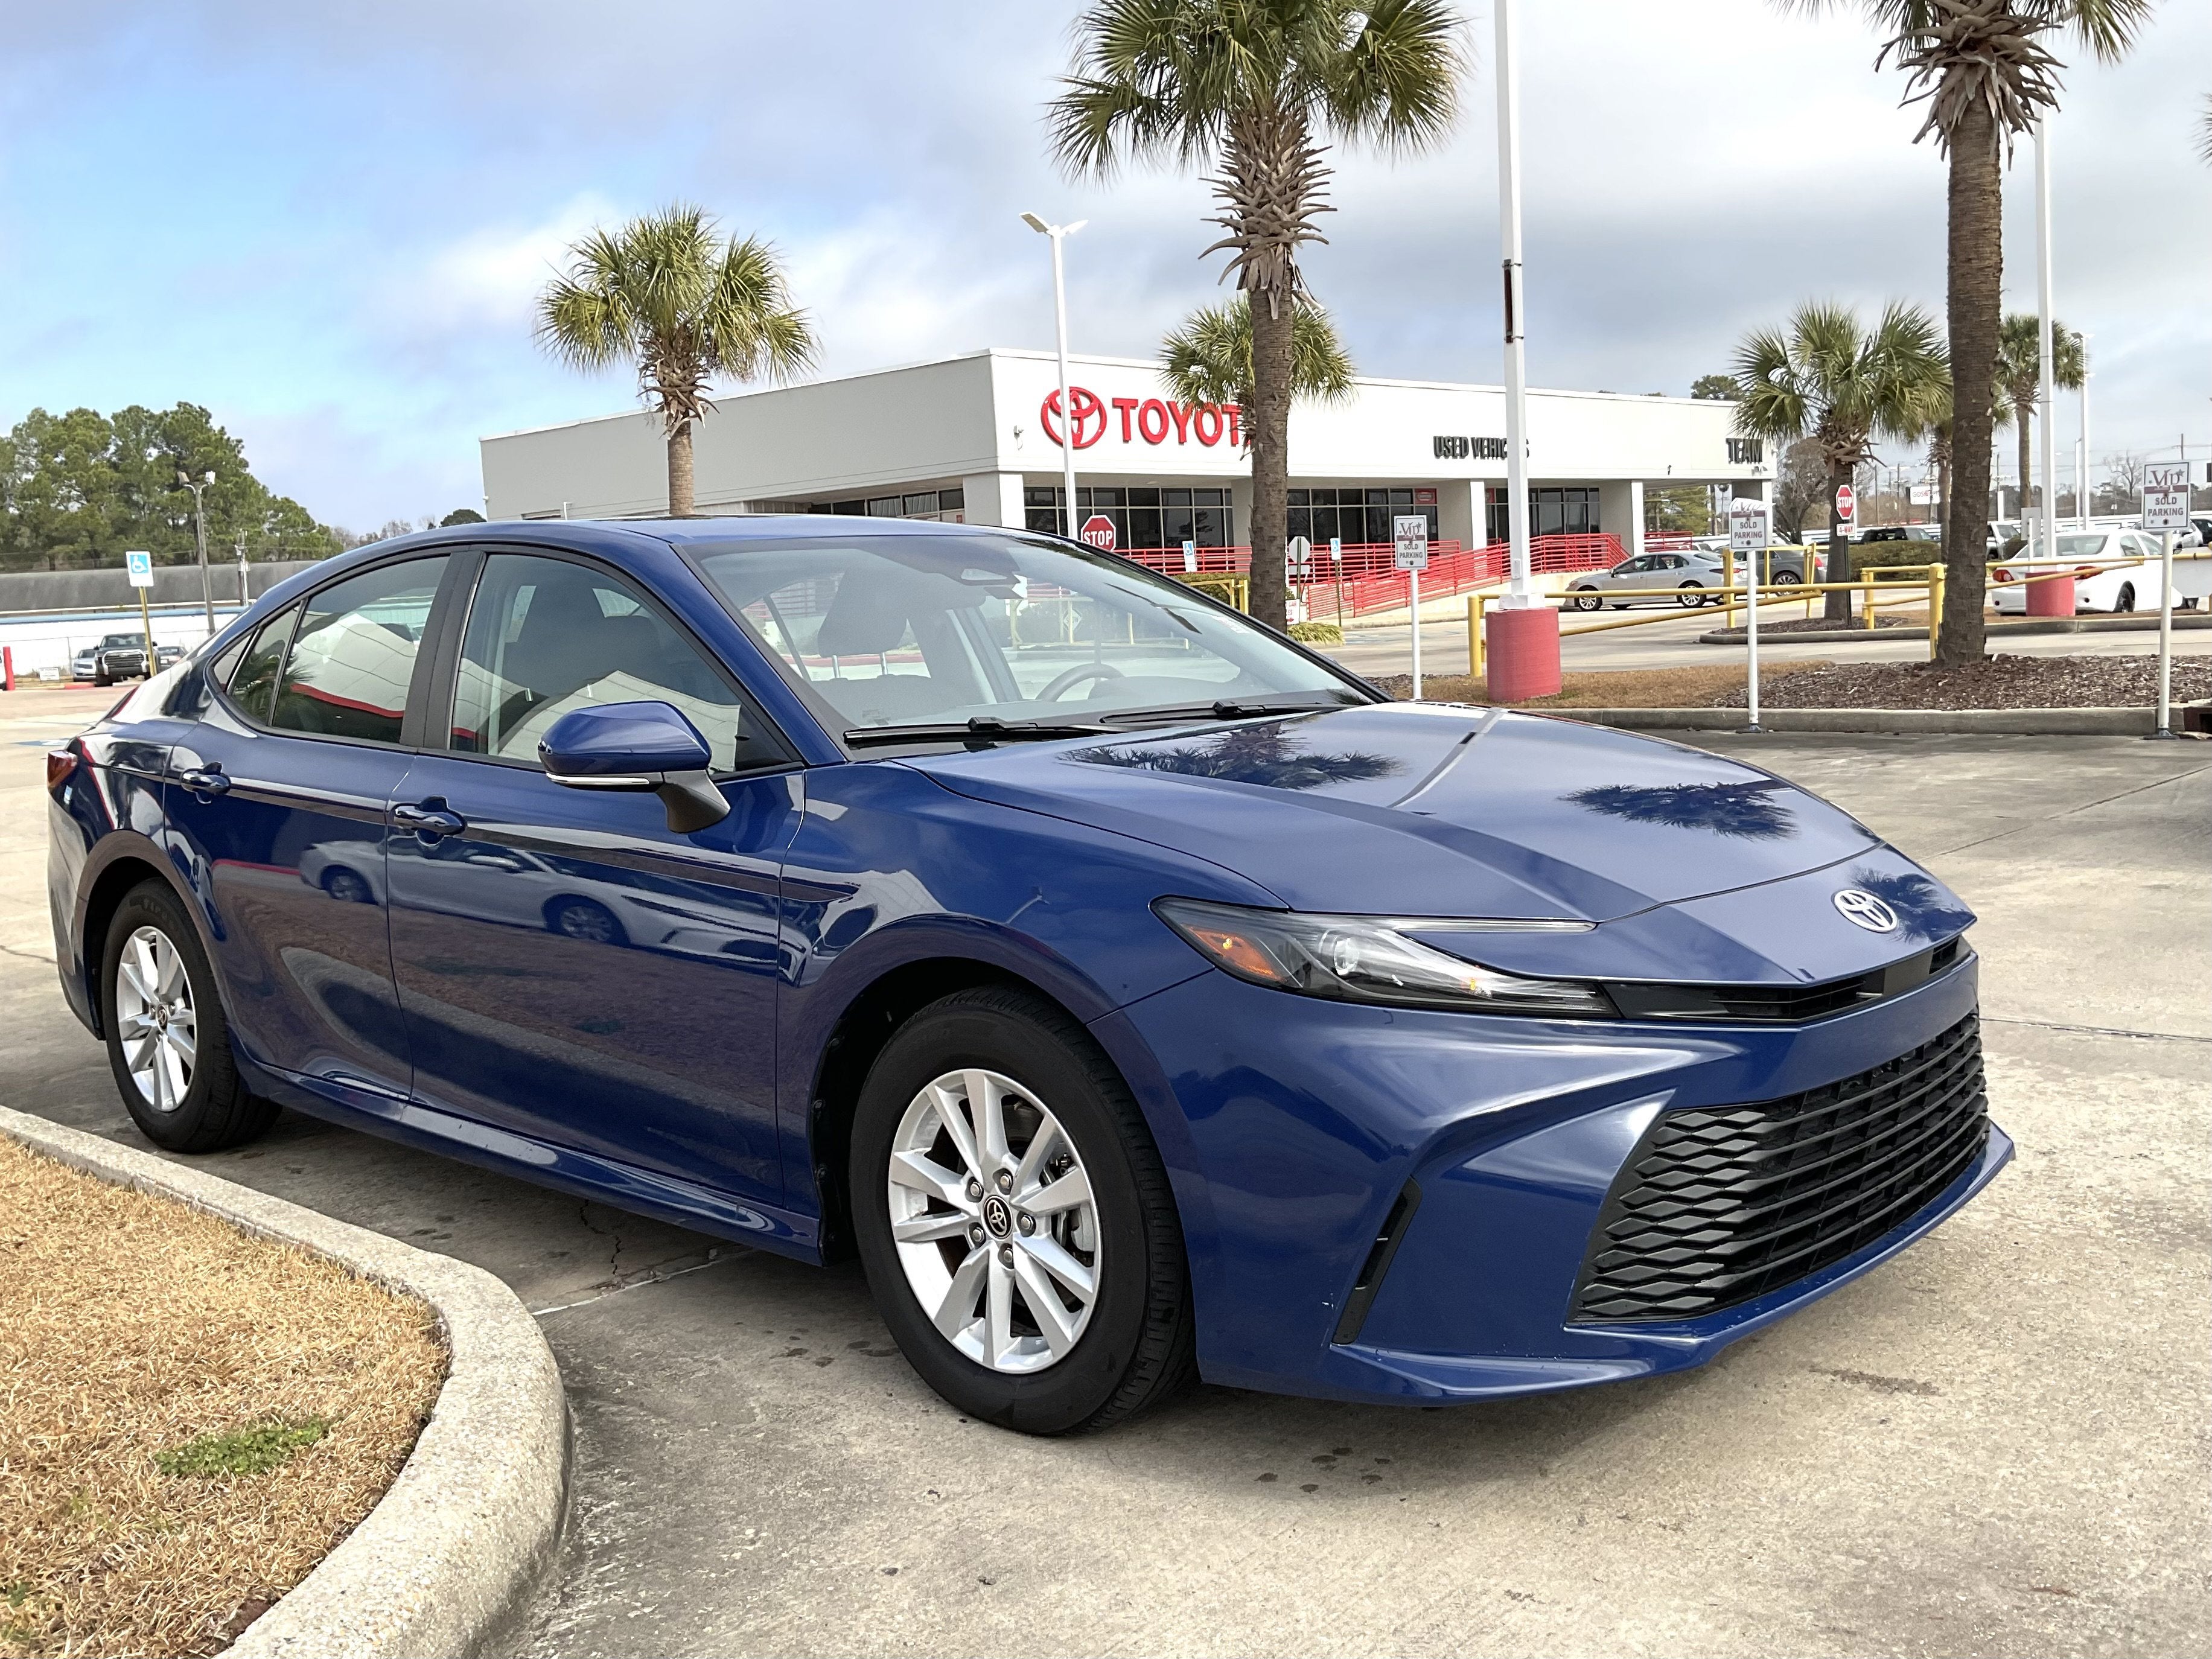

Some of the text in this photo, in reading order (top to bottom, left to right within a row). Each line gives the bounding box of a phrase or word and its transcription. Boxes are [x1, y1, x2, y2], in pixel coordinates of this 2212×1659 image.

[1112, 397, 1251, 446] TOYOT
[1433, 436, 1529, 460] USED VEHIC
[1726, 438, 1763, 464] TEAM
[1837, 496, 1853, 508] STOP
[2155, 497, 2177, 505] SOLD
[2147, 508, 2184, 517] PARKING
[1083, 530, 1113, 546] STOP
